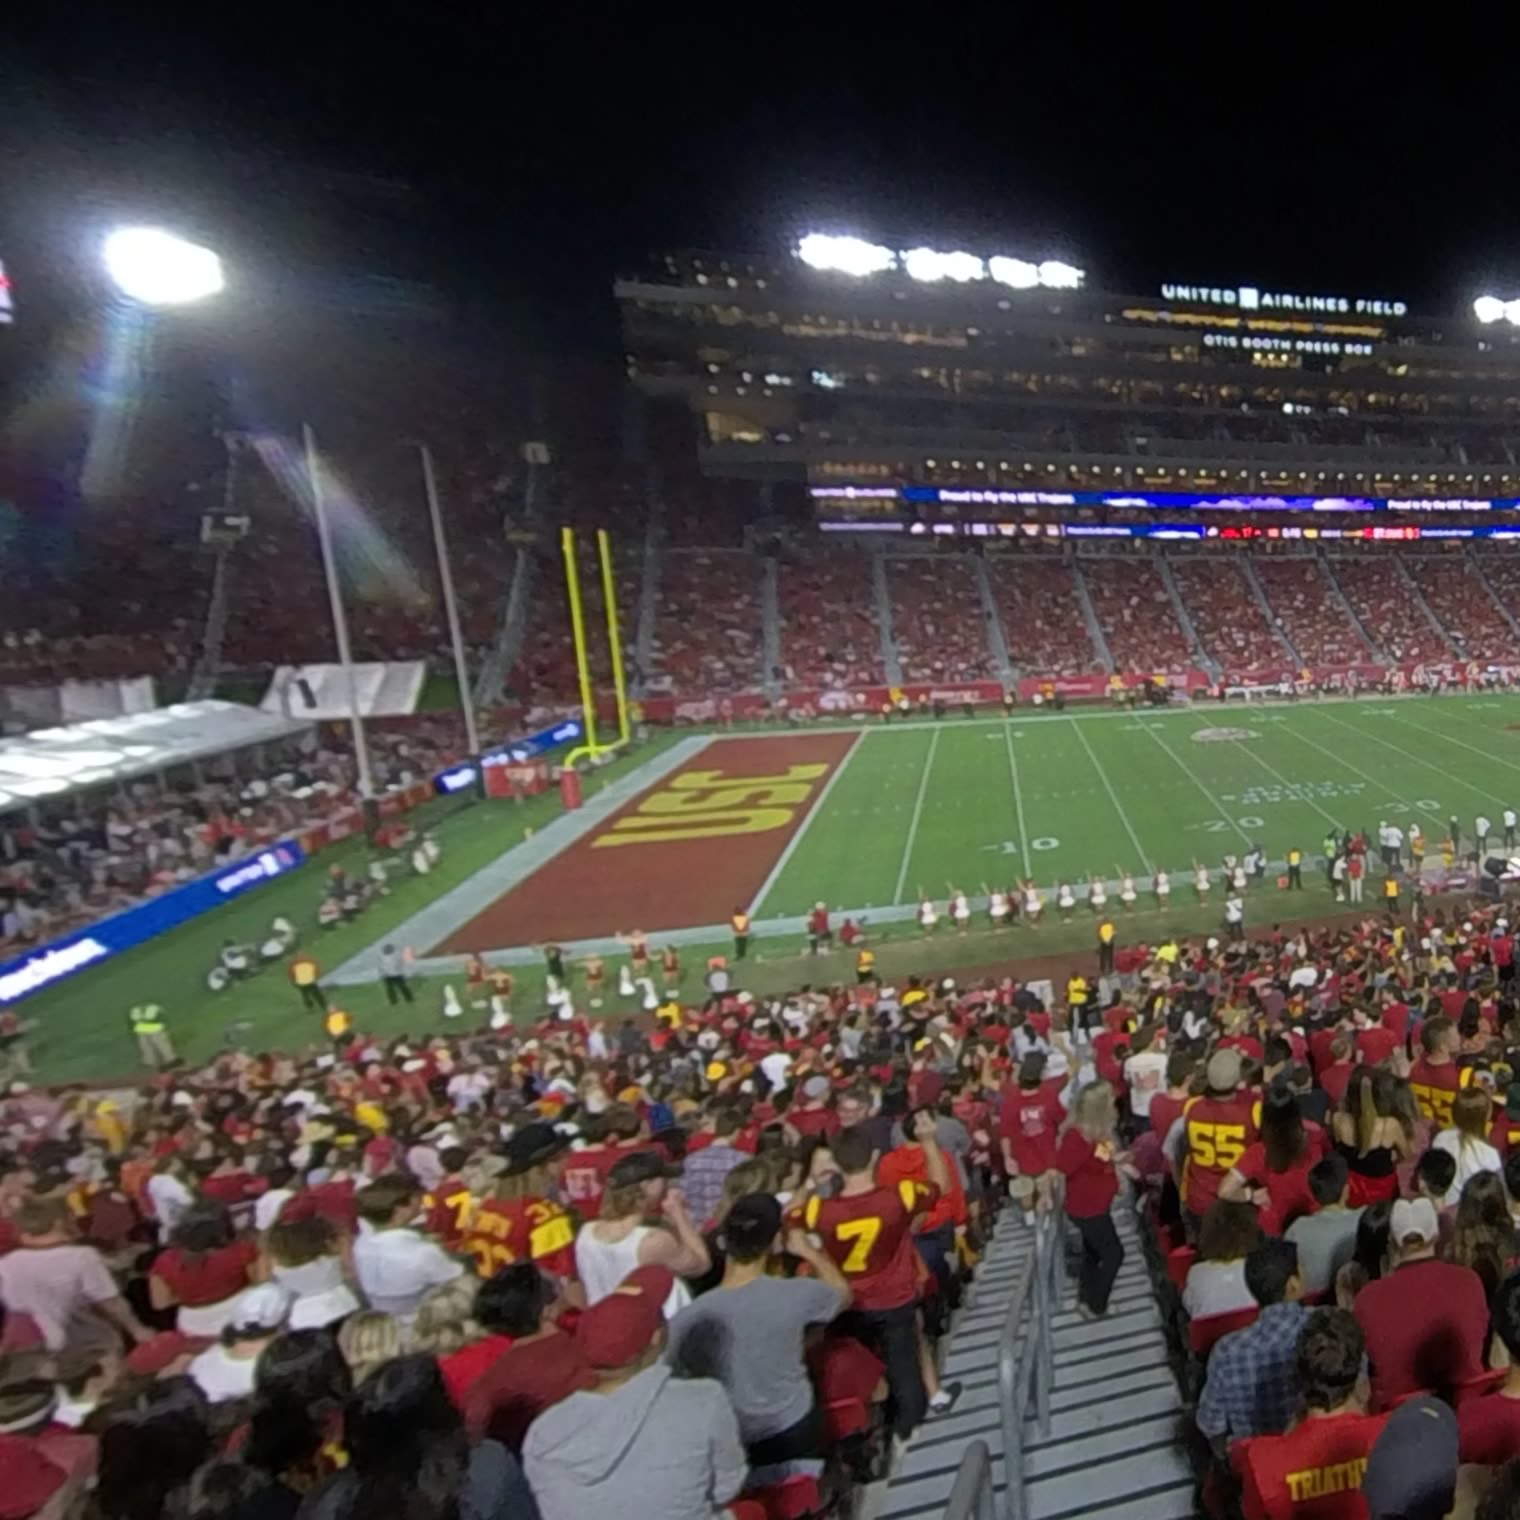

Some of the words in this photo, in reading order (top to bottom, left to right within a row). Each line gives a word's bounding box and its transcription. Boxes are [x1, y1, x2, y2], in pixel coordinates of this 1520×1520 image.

[1161, 283, 1237, 304] UNITED
[1261, 292, 1349, 312] AIRLINES
[1356, 299, 1407, 316] FIELD
[1203, 333, 1238, 348] OTIS
[1242, 337, 1292, 351] BOOTH
[1296, 340, 1340, 354] PRESS
[590, 762, 829, 848] USC
[1203, 815, 1264, 832] 20
[1001, 837, 1059, 854] 10
[1189, 1120, 1245, 1169] 55
[444, 1190, 472, 1229] 7
[836, 1216, 881, 1272] 7
